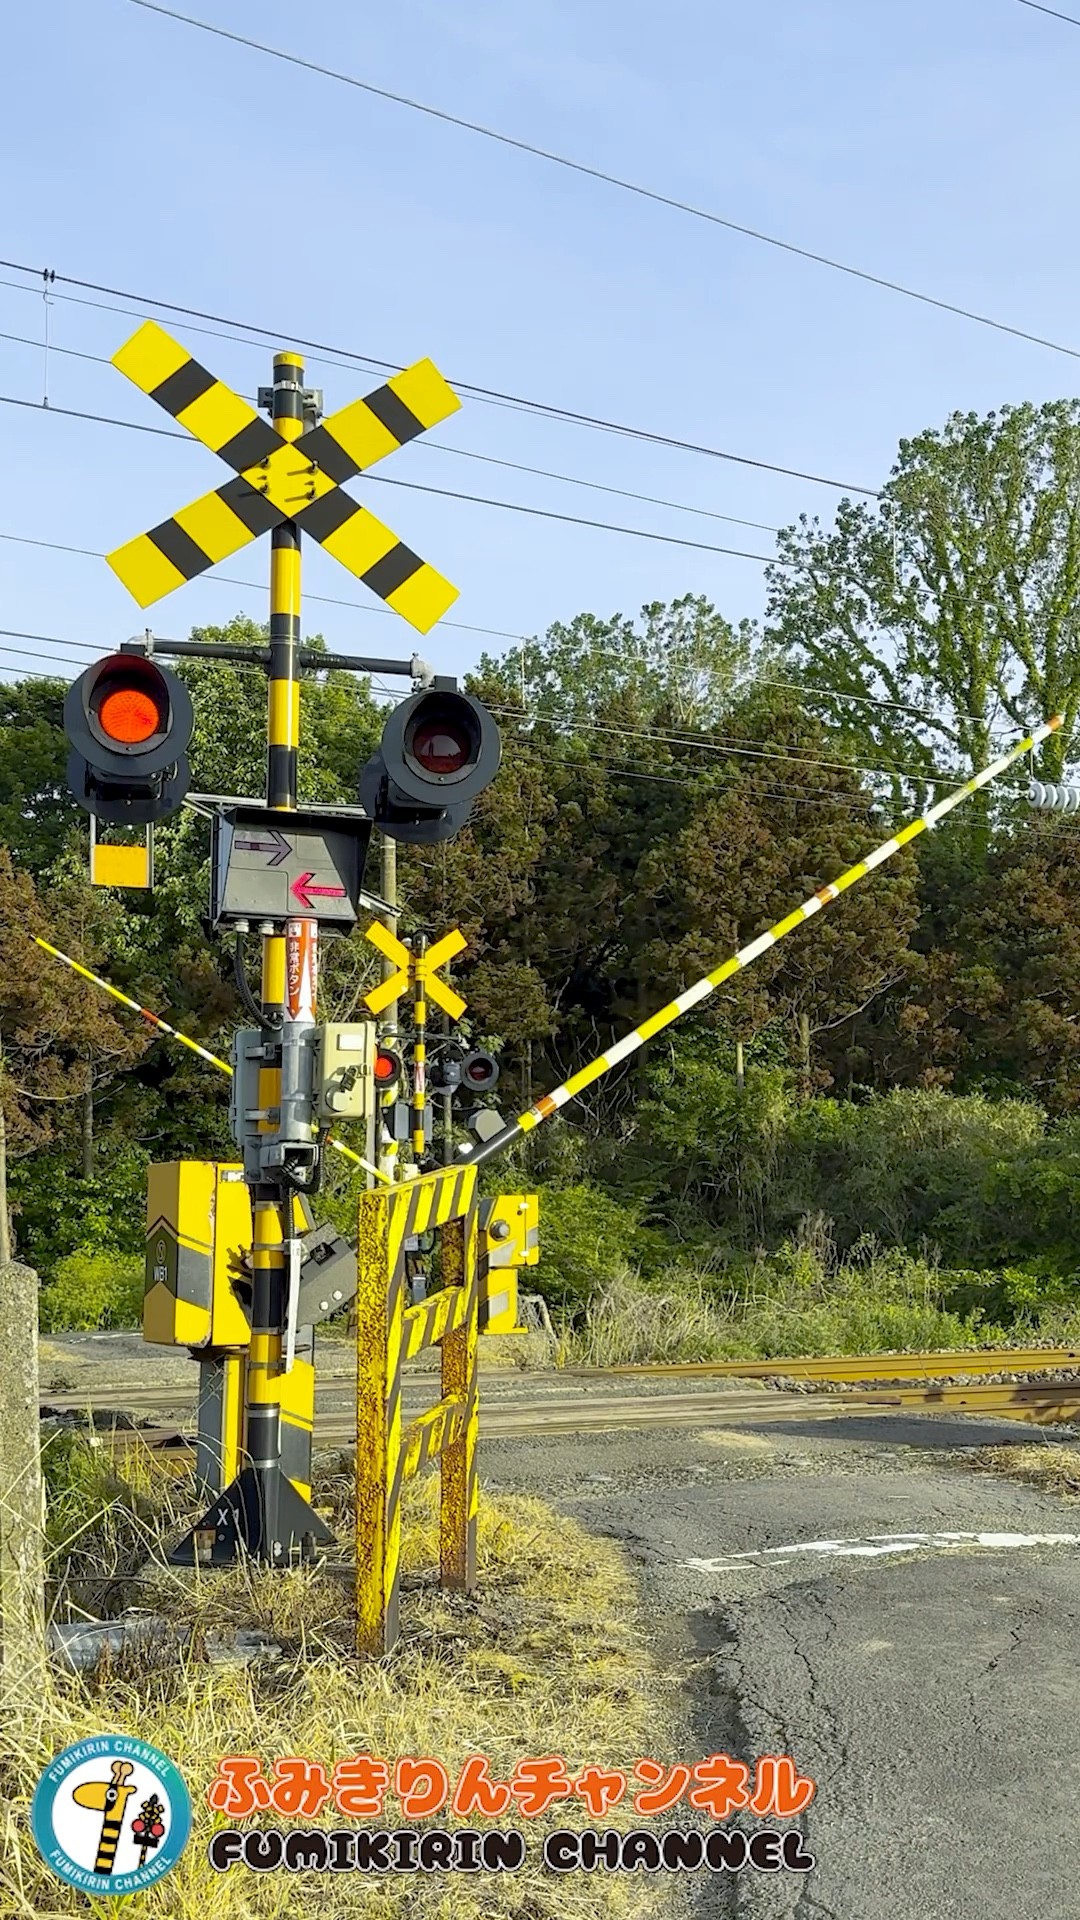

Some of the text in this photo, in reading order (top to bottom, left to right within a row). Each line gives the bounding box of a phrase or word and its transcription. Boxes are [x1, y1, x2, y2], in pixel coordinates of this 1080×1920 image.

[289, 941, 300, 996] 非常ボタン
